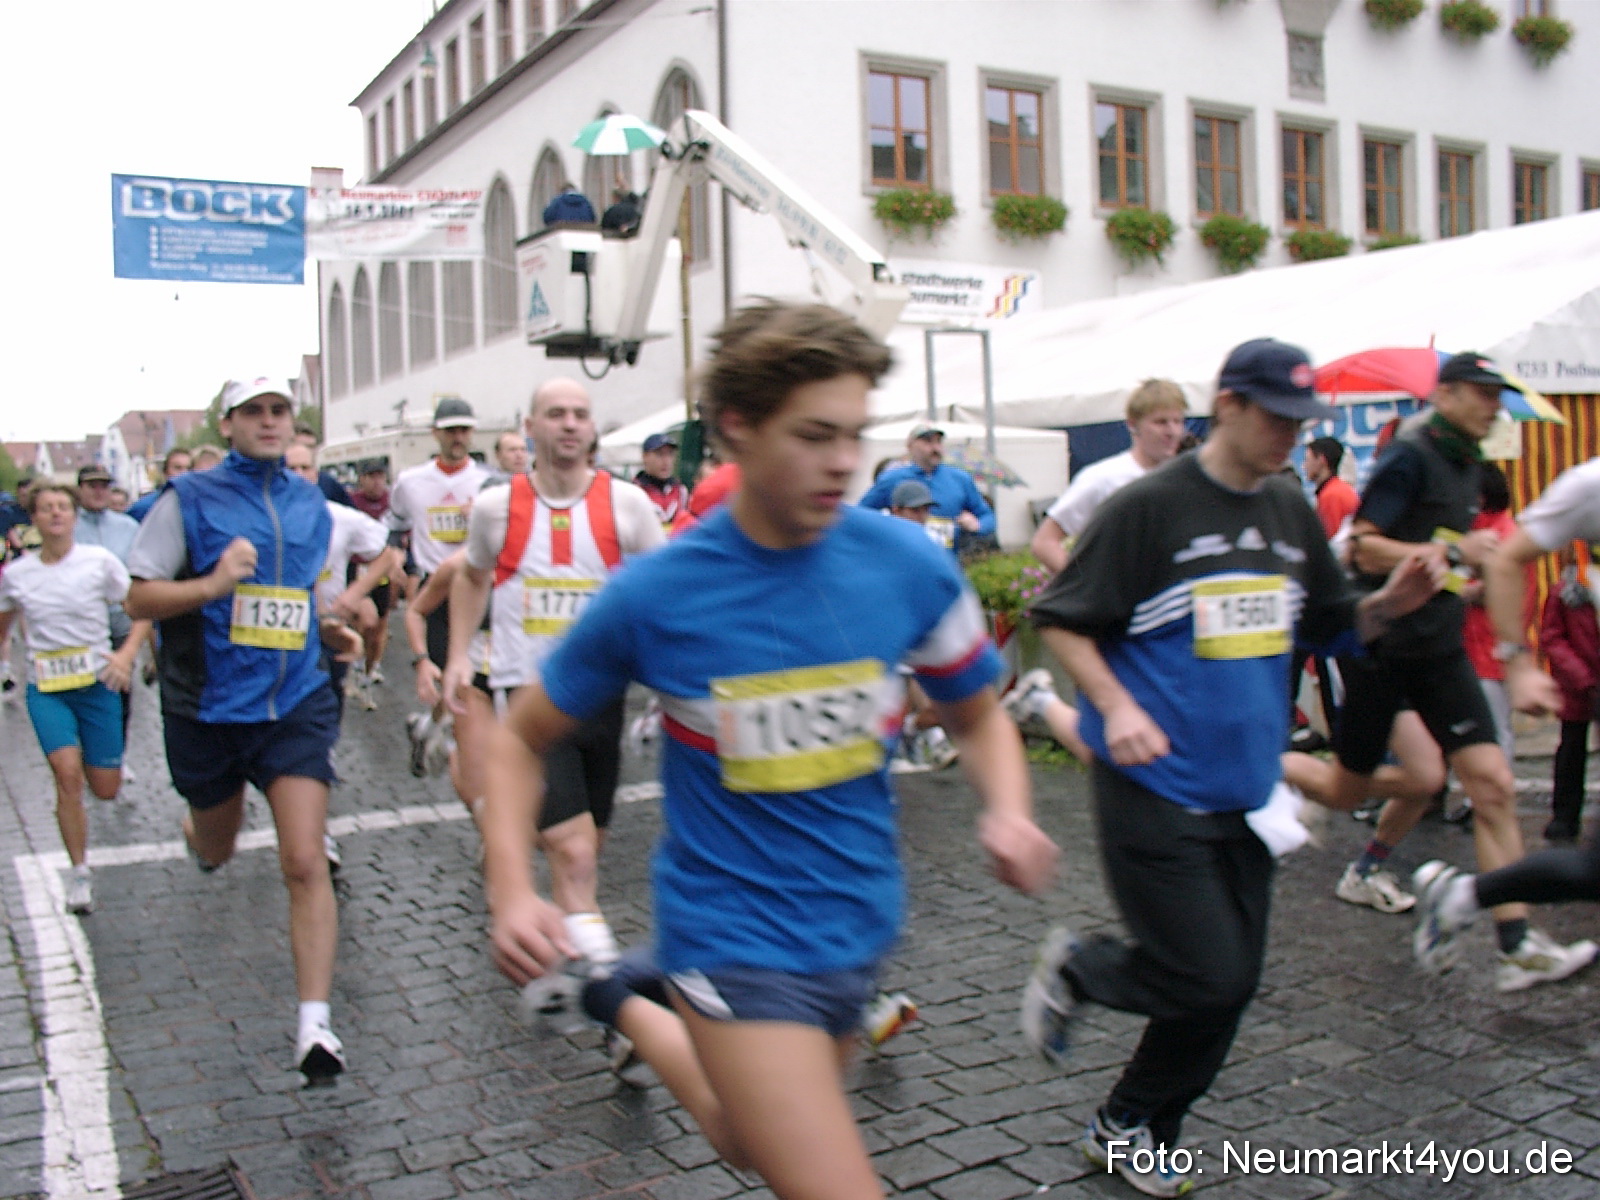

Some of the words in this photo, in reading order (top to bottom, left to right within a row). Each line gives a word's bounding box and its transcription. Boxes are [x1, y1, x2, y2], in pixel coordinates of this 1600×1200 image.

[122, 178, 296, 226] BOCK
[901, 272, 984, 289] stadtwerke
[251, 600, 303, 629] 1327
